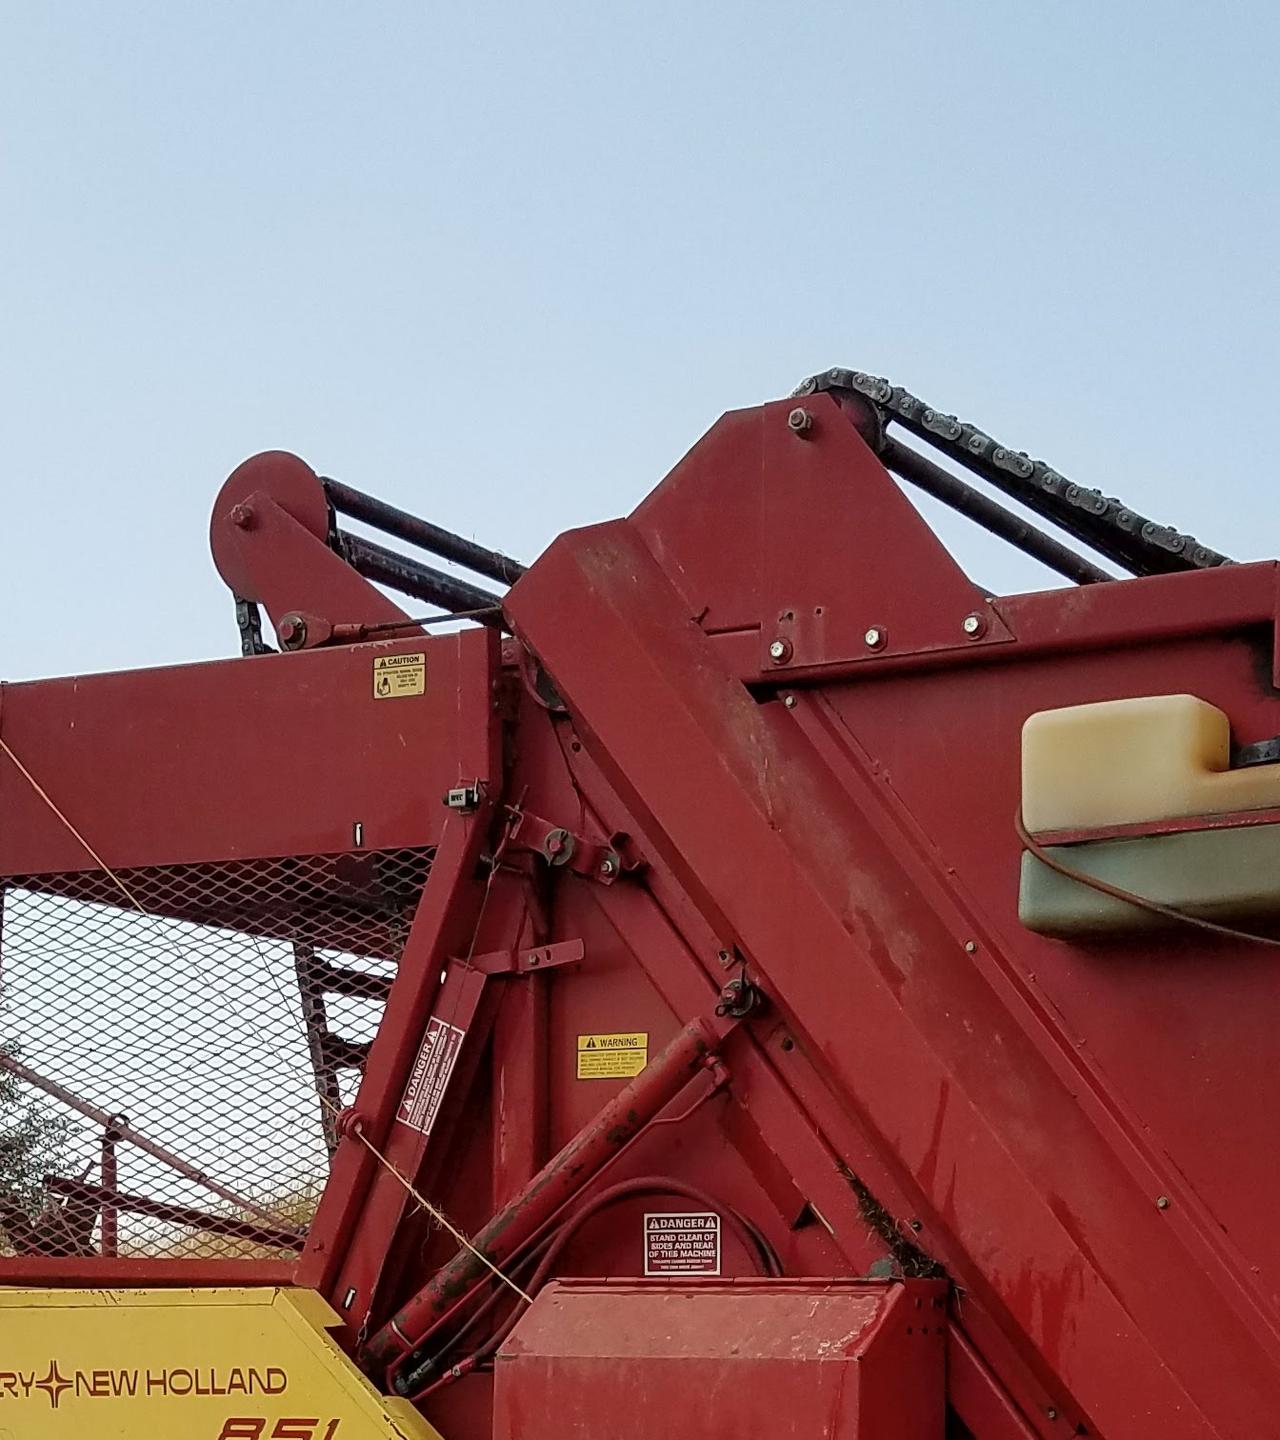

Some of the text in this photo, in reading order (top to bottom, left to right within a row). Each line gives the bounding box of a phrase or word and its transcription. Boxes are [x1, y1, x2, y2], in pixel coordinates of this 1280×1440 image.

[387, 656, 420, 666] CAUTION
[600, 1037, 638, 1048] WARNING
[408, 1044, 432, 1097] DANGER
[660, 1218, 705, 1229] DANGER
[650, 1233, 715, 1242] STAND CLEAR OF
[650, 1242, 673, 1250] SIDES
[693, 1241, 714, 1249] REAR
[648, 1250, 659, 1258] OF
[679, 1249, 716, 1257] MACHINE
[75, 1369, 139, 1397] NEW
[146, 1367, 288, 1396] HOLLAND
